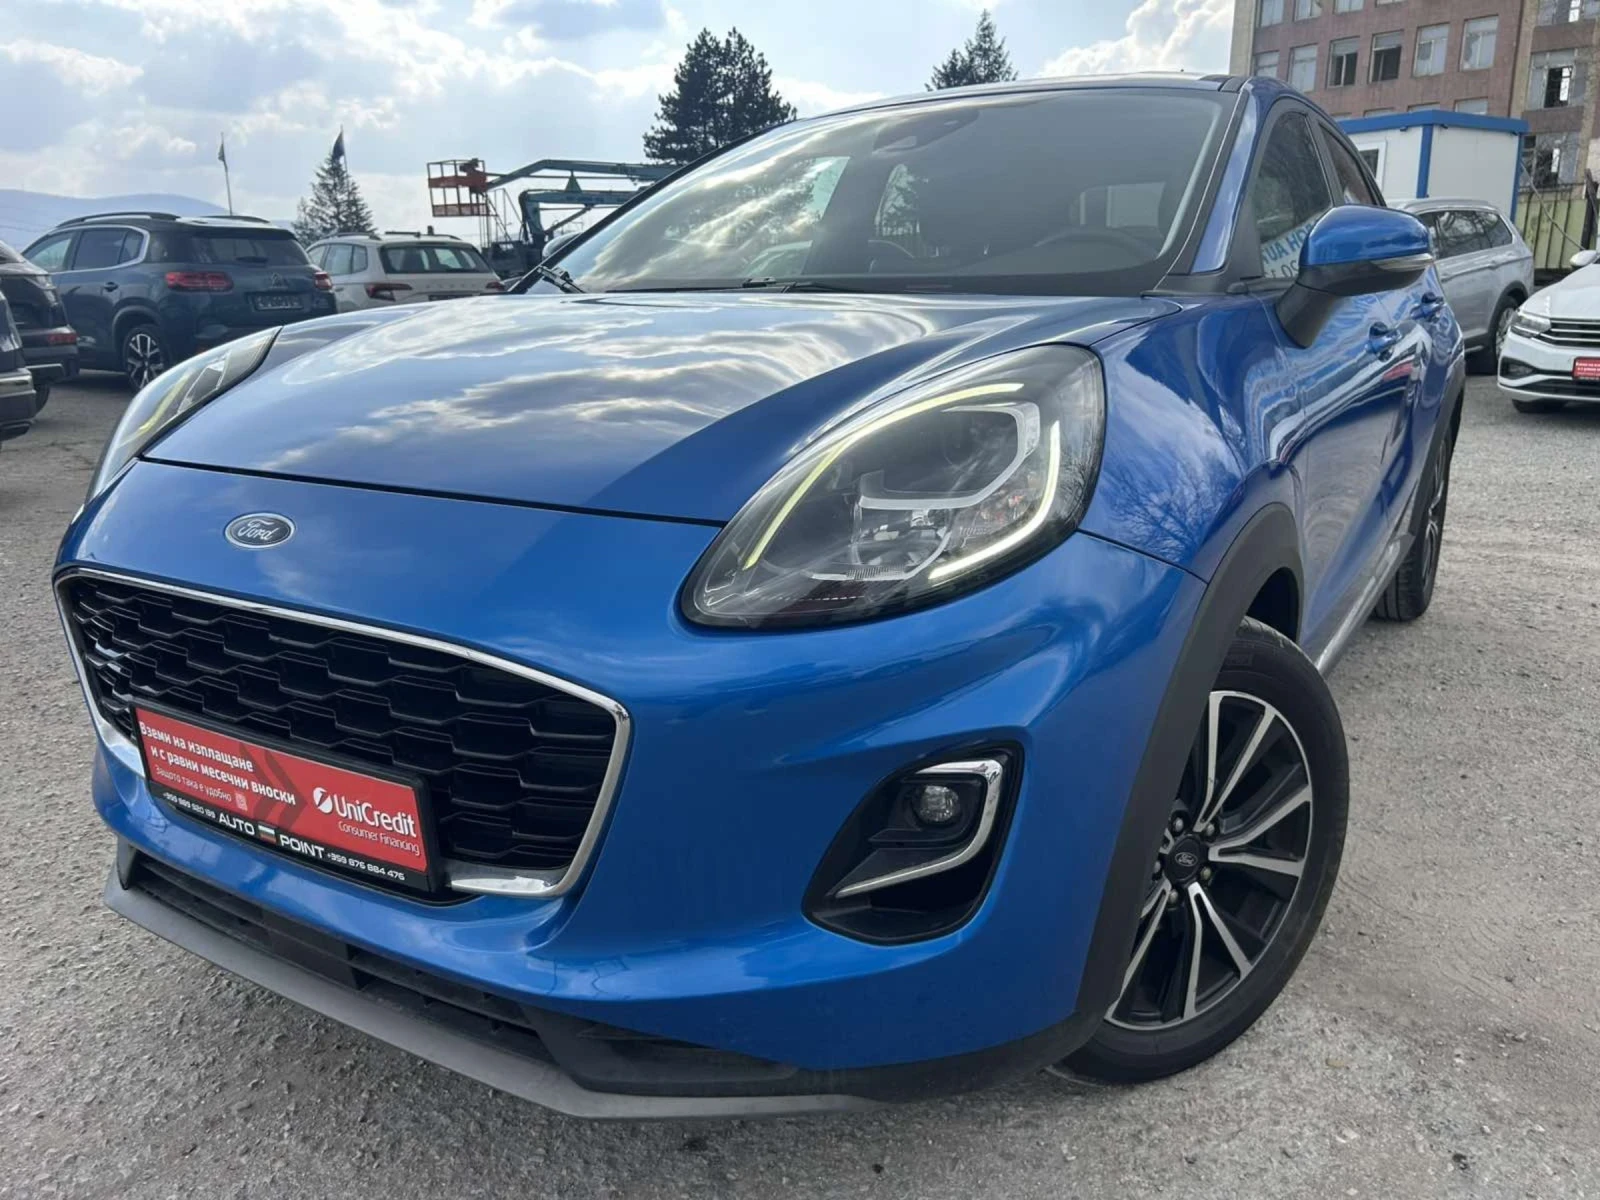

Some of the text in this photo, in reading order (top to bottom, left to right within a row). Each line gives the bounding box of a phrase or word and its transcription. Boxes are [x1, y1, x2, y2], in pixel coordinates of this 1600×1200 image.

[238, 519, 280, 541] Ford
[139, 721, 254, 773] Вземи на изплащане
[150, 745, 296, 806] и с равни месечни вноски
[181, 776, 199, 790] така
[204, 785, 233, 803] удобно
[333, 793, 417, 838] UniCredit
[219, 812, 256, 836] AUTO
[280, 834, 325, 859] POINT
[327, 851, 348, 865] +359
[387, 868, 405, 881] 476
[338, 820, 421, 857] Consumer Financing
